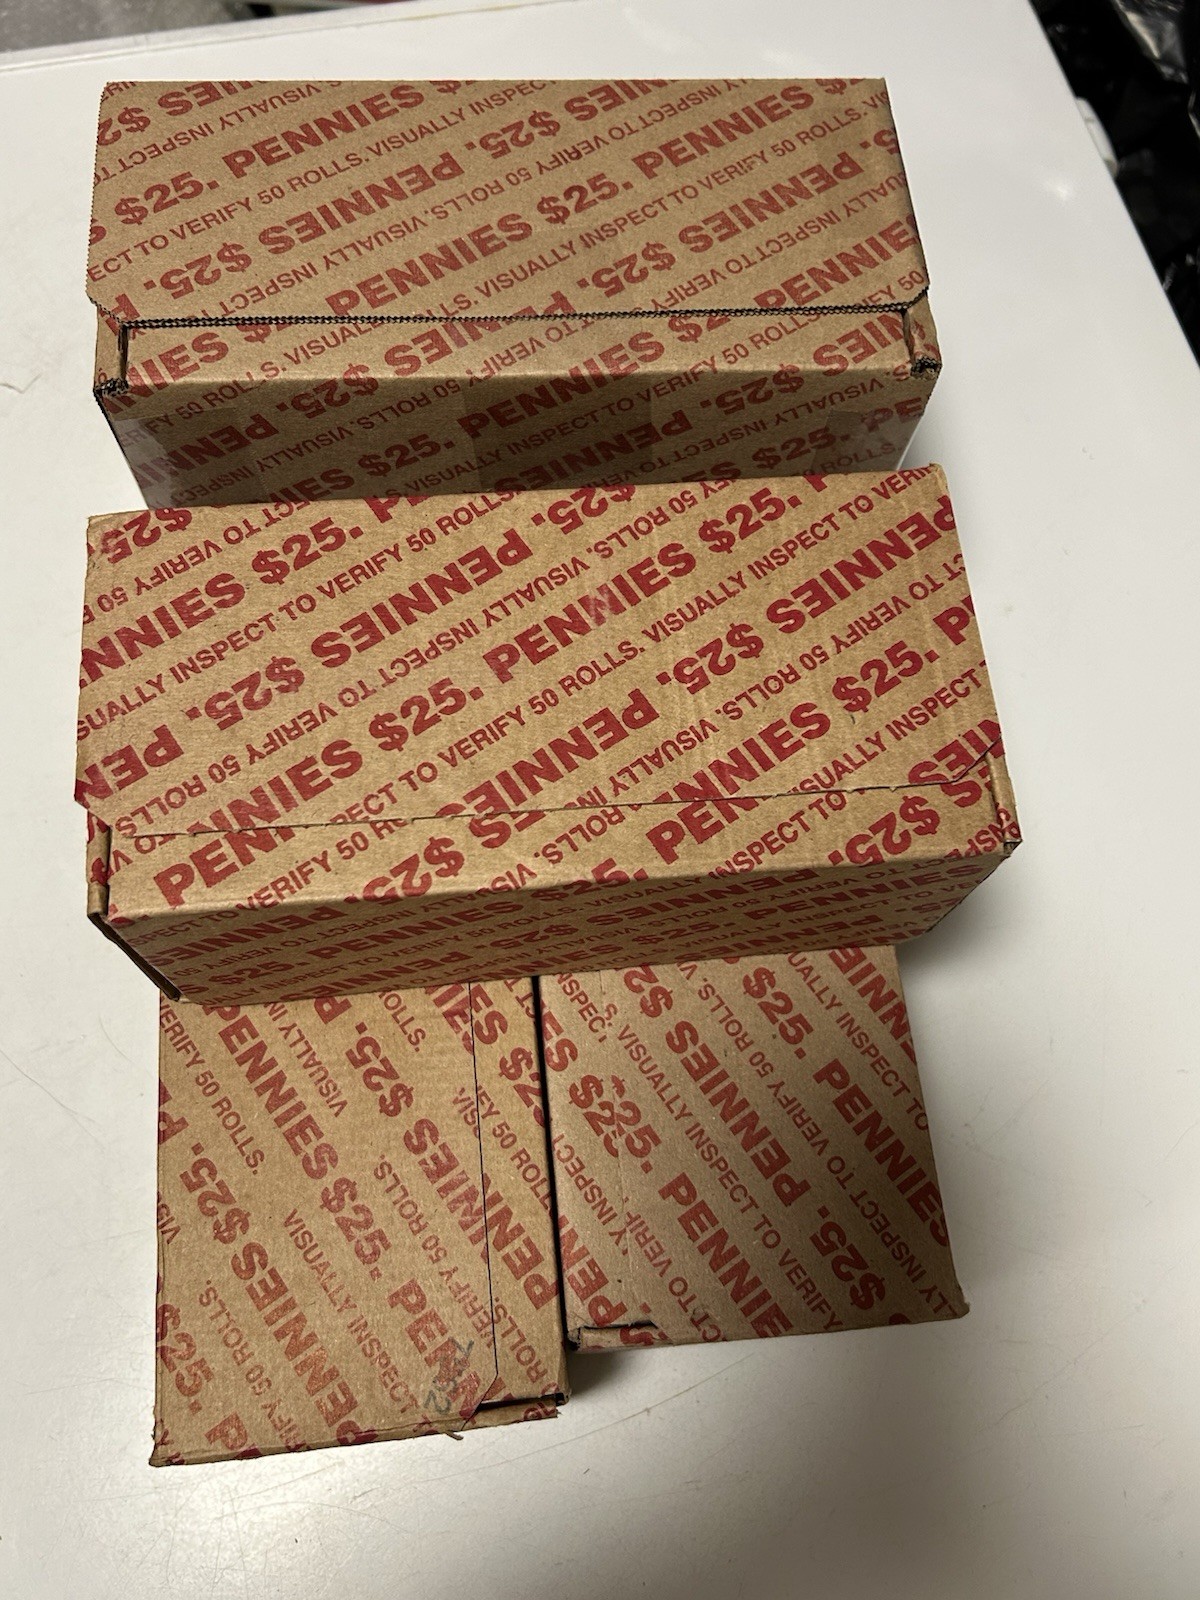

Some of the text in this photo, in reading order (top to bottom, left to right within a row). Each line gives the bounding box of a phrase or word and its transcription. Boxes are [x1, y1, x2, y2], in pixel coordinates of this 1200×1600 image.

[219, 83, 321, 130] VISUALLY
[222, 84, 425, 179] PENNIES
[464, 110, 560, 159] $25.
[118, 122, 215, 173] INSPECT
[134, 107, 470, 256] TO VERIFY 50 ROLLS. VISUALLY
[114, 171, 220, 226] $25.
[221, 82, 722, 317] INSPECT TO VERIFY 50 ROLLS. VISUALLY INSPECT
[258, 152, 464, 255] PENNIES
[325, 85, 814, 317] PENNIES $25. PENNIES
[475, 241, 577, 298] VISUALLY
[579, 197, 669, 249] INSPECT
[668, 185, 698, 204] TO
[697, 150, 769, 191] VERIFY
[771, 140, 796, 158] 50
[795, 108, 868, 146] ROLLS.
[576, 152, 864, 298] PENNIES $25.
[143, 242, 252, 299] $25.
[651, 210, 842, 311] INSPECT TO VERIFY
[897, 270, 925, 291] 50
[545, 320, 581, 342] TO
[177, 400, 203, 419] 50
[276, 362, 379, 419] $25.
[350, 392, 432, 430] ROLLS.
[358, 332, 665, 477] $25. PENNIES
[405, 343, 749, 498] VISUALLY INSPECT TO VERIFY 50
[433, 381, 461, 398] 50
[701, 363, 804, 415] $25.
[775, 379, 884, 427] VISUALLY
[256, 425, 354, 472] VISUALLY
[494, 409, 693, 492] PENNIES
[641, 455, 671, 474] TO
[675, 420, 768, 460] INSPECT
[752, 427, 850, 470] $25.
[586, 506, 670, 558] ROLLS.
[668, 490, 698, 514] 50
[97, 518, 260, 612] TO VERIFY 50
[251, 517, 364, 585] $25.
[766, 495, 956, 634] PENNIES
[908, 573, 944, 600] TO
[169, 528, 437, 684] INSPECT TO VERIFY 50
[311, 528, 533, 667] PENNIES
[369, 487, 802, 752] $25. PENNIES $25.
[482, 556, 590, 628] VISUALLY
[831, 596, 910, 654] VERIFY
[378, 618, 480, 688] INSPECT
[398, 494, 874, 791] TO VERIFY 50 ROLLS. VISUALLY INSPECT TO
[656, 623, 764, 695] $25.
[800, 645, 829, 671] 50
[832, 641, 940, 713] $25.
[184, 656, 305, 731] $25.
[338, 680, 377, 708] TO
[715, 663, 801, 720] ROLLS.
[886, 668, 982, 740] INSPECT
[207, 754, 241, 783] 50
[245, 702, 338, 765] VERIFY
[609, 720, 719, 797] VISUALLY
[534, 805, 626, 864] ROLLS.
[808, 791, 847, 820] TO
[828, 796, 941, 868] $25.
[199, 910, 239, 922] TO
[336, 831, 369, 860] 50
[586, 868, 820, 926] PENNIES
[632, 864, 984, 945] $25. PENNIES
[143, 906, 348, 967] PENNIES
[209, 902, 524, 985] $25. PENNIES
[280, 937, 317, 948] TO
[317, 909, 417, 938] INSPECT
[382, 935, 462, 958] VERIFY
[584, 877, 700, 908] VISUALLY
[474, 924, 579, 950] $25.
[674, 914, 884, 960] PENNIES
[159, 1003, 204, 1069] VERIFY
[195, 1069, 220, 1097] 50
[212, 1096, 264, 1175] ROLLS.
[278, 1022, 348, 1117] VISUALLY
[345, 1022, 414, 1117] $25.
[836, 1012, 929, 1131] INSPECT TO
[492, 1121, 517, 1149] 50
[665, 1021, 811, 1207] PENNIES
[698, 978, 927, 1283] INSPECT TO VERIFY 50 ROLLS.
[742, 967, 814, 1060] $25.
[813, 1059, 949, 1247] PENNIES
[180, 1142, 251, 1244] $25.
[374, 1154, 428, 1235] ROLLS.
[617, 1025, 843, 1331] VISUALLY INSPECT TO VERIFY
[284, 1208, 357, 1312] VISUALLY
[320, 1177, 392, 1282] $25.
[810, 1205, 886, 1310] $25.
[669, 1277, 697, 1313] TO
